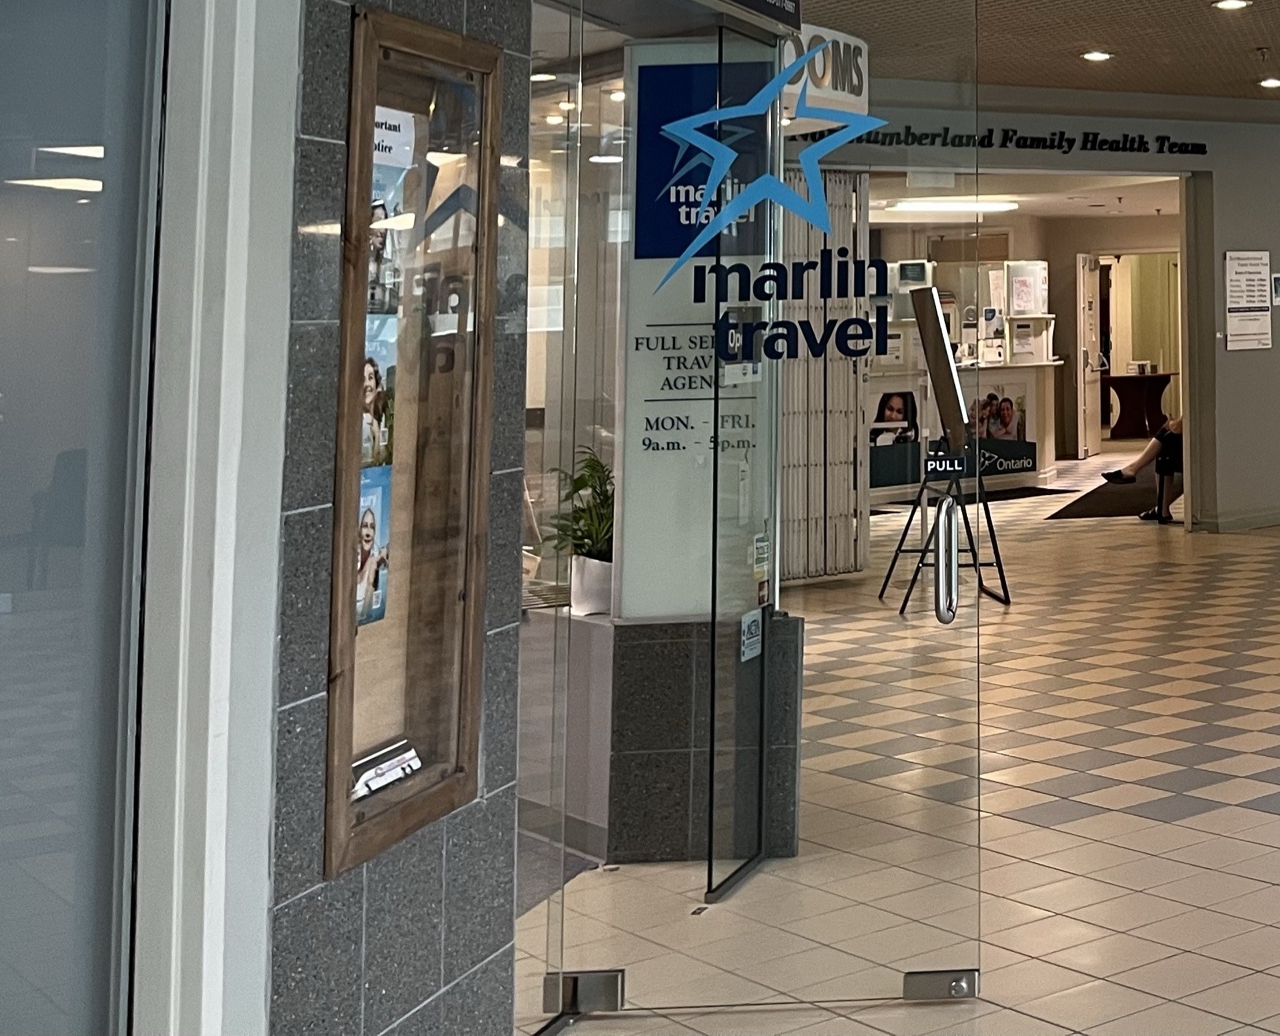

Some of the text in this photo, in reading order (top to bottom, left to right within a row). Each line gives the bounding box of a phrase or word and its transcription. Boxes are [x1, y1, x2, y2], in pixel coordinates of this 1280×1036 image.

[1000, 128, 1076, 154] Family
[1080, 132, 1150, 153] Health
[1155, 135, 1208, 155] Team
[693, 247, 888, 303] marlin
[714, 306, 888, 361] travel
[634, 336, 682, 352] FULL
[644, 416, 695, 431] MON.
[720, 414, 755, 429] FRI.
[642, 437, 686, 451] 9a.m.
[927, 460, 963, 472] PULL
[997, 457, 1033, 471] Ontario
